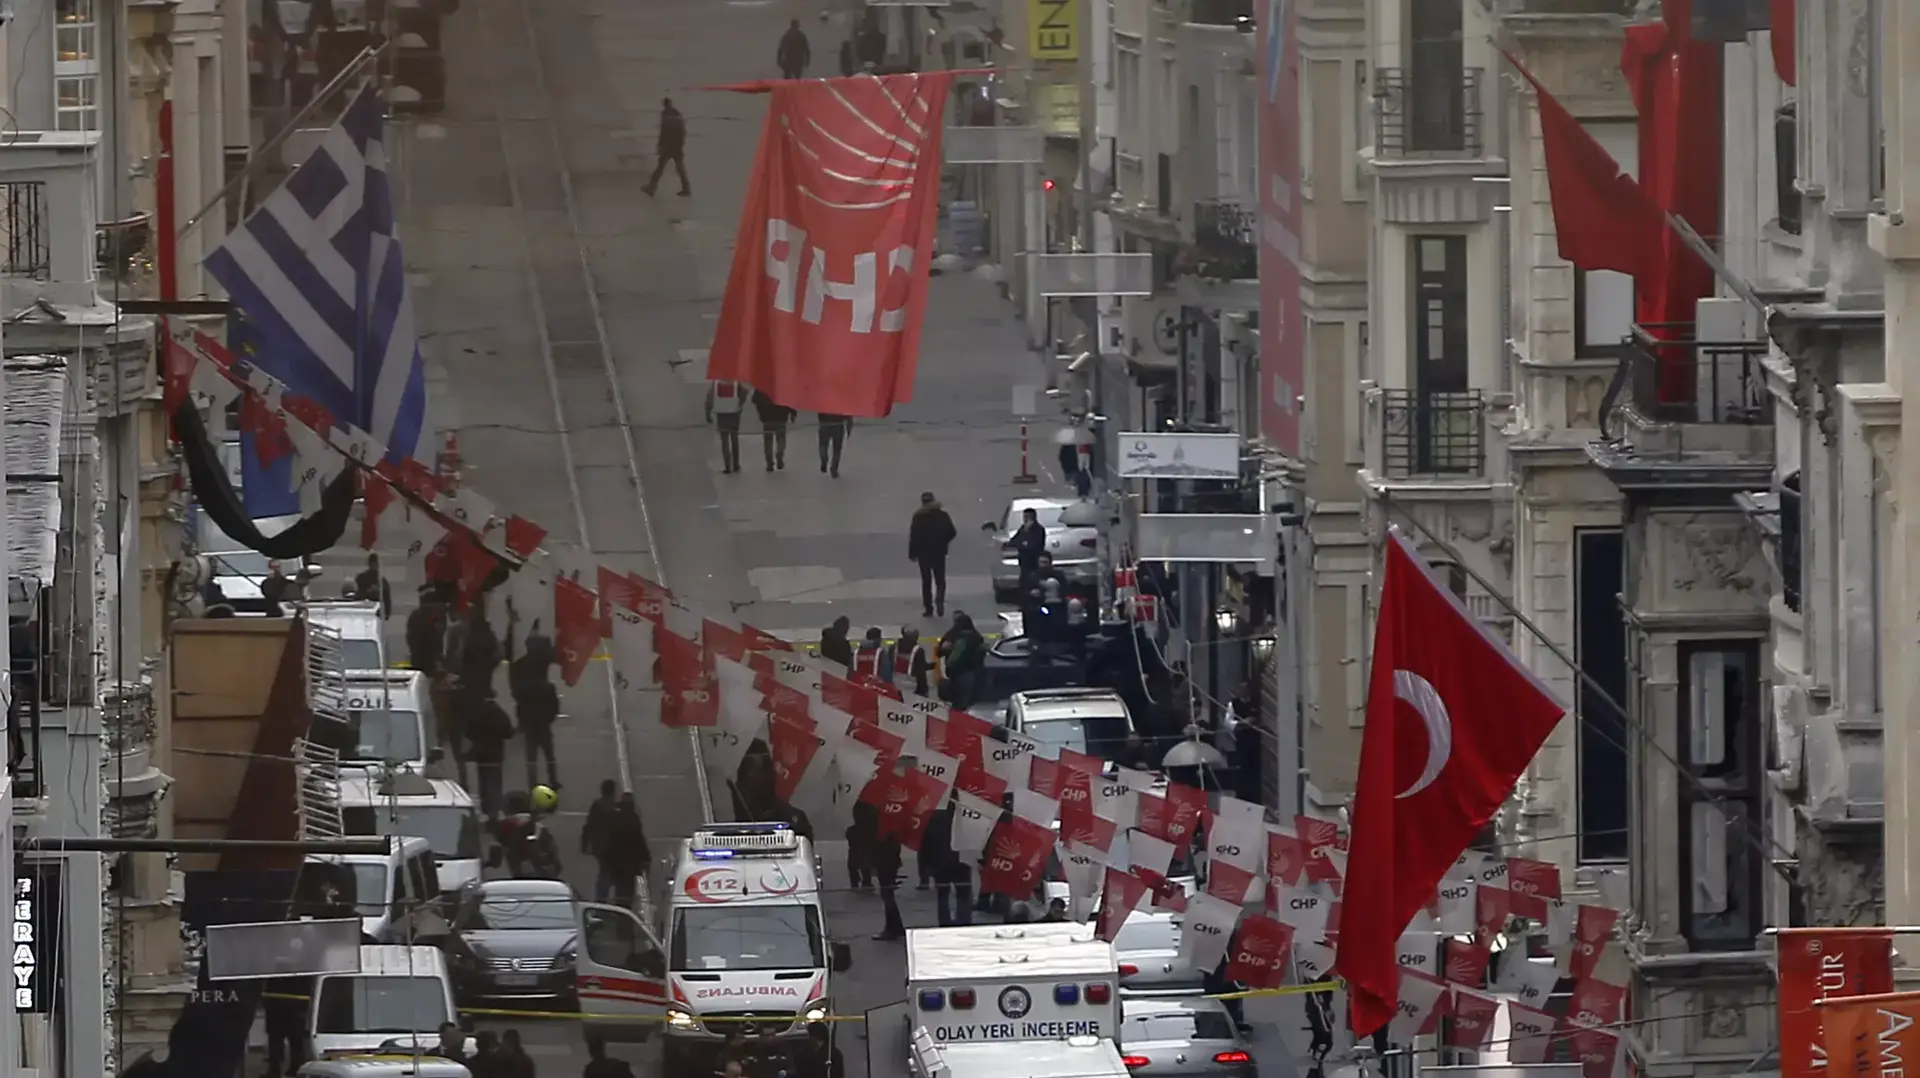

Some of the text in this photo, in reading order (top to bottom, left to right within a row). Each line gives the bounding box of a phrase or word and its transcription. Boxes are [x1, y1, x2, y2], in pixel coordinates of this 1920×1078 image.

[886, 711, 914, 725] CHP
[992, 749, 1020, 762] CHP
[922, 763, 946, 777] HP
[1060, 787, 1088, 802] CHP
[1102, 785, 1130, 798] CHP
[1483, 864, 1508, 881] CHP
[700, 878, 738, 890] 112
[1290, 898, 1318, 911] CHP
[1194, 922, 1222, 935] CHP
[1237, 952, 1266, 966] CHP
[1399, 954, 1427, 966] CHP
[191, 989, 240, 1003] PERA
[935, 1025, 976, 1041] OLAY
[1514, 1021, 1542, 1034] CHP
